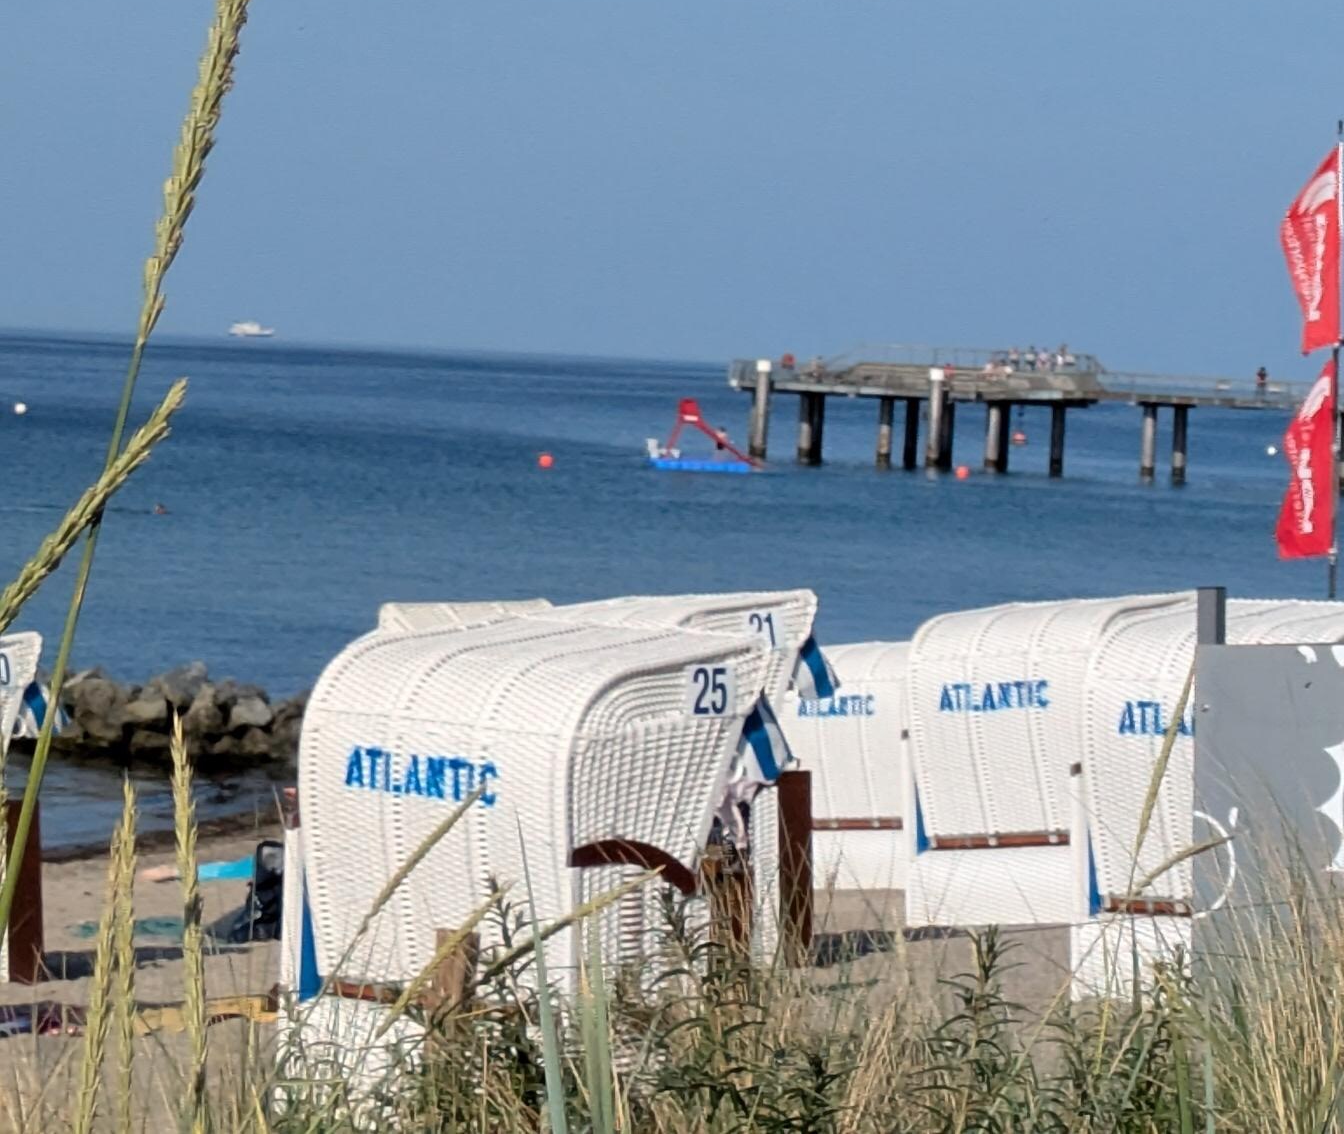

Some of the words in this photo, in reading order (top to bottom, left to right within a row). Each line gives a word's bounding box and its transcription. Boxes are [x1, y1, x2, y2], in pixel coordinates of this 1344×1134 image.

[693, 668, 727, 715] 25
[940, 680, 1049, 711] ATLANTIC
[345, 746, 498, 806] ATLANTIC
